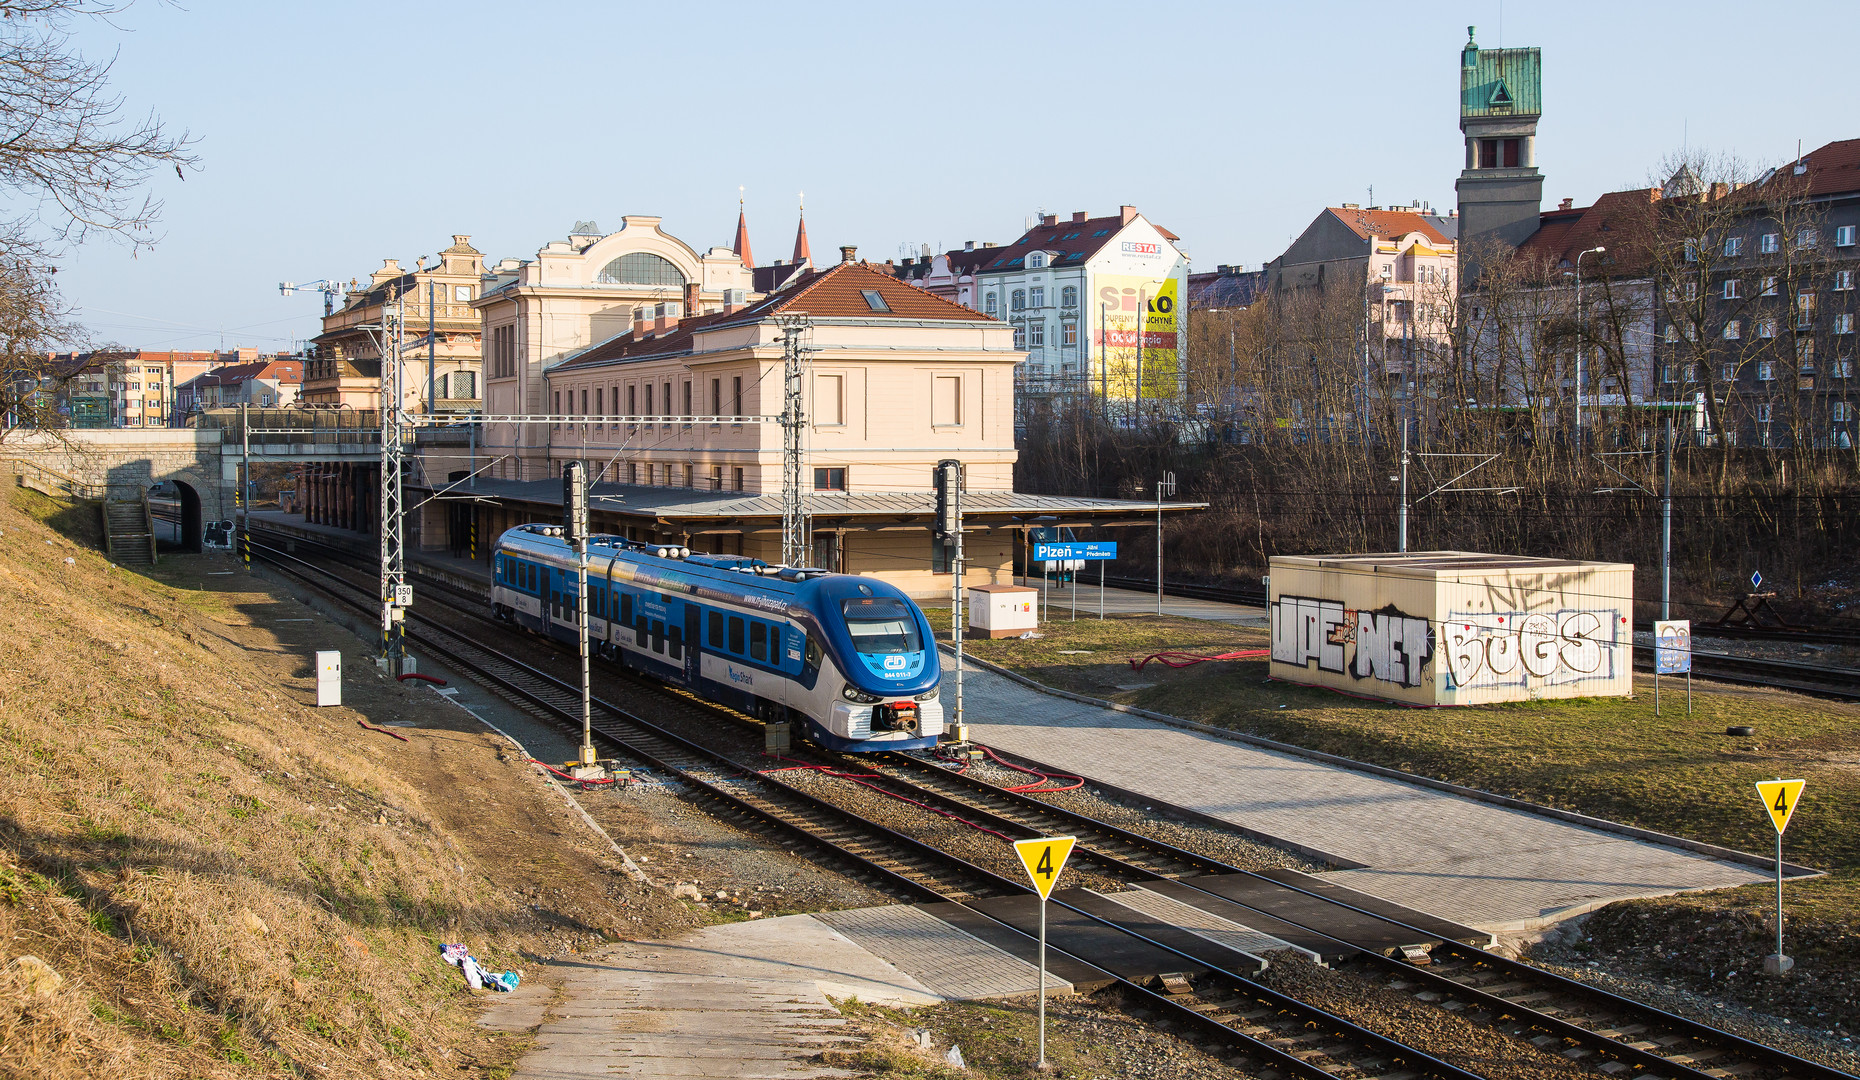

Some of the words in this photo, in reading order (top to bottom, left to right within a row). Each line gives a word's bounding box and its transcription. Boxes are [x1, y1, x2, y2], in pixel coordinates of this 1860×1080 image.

[1122, 242, 1161, 254] RESTAF
[1141, 315, 1173, 325] KUCHYNĚ
[1038, 546, 1072, 558] Plzeň
[1441, 612, 1601, 688] BUGS
[1774, 787, 1788, 816] 4
[1036, 846, 1054, 879] 4
